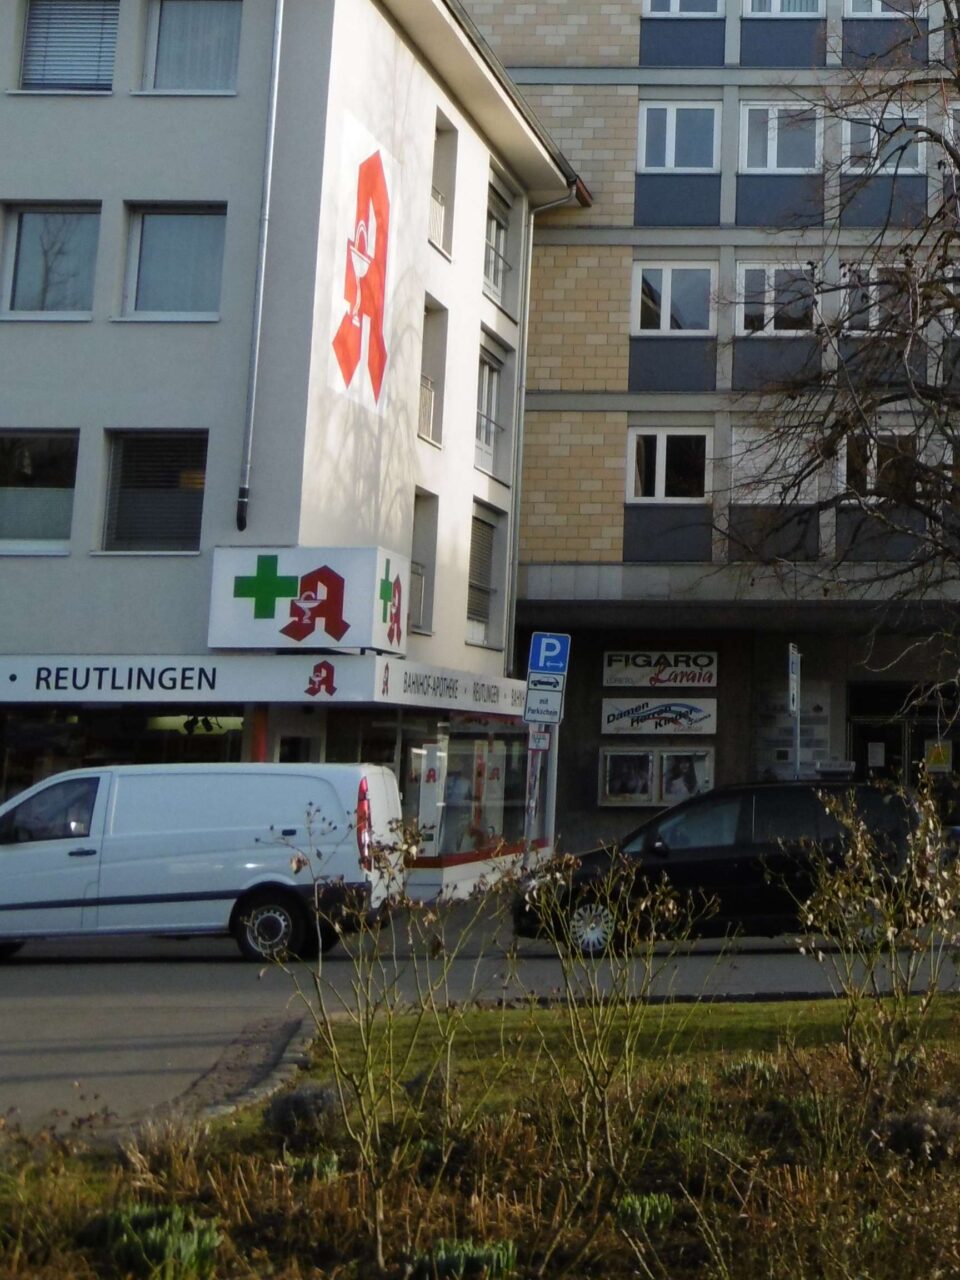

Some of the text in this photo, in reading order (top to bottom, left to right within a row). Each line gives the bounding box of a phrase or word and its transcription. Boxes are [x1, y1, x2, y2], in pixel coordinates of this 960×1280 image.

[539, 637, 561, 667] P
[607, 653, 715, 668] FIGARO
[35, 667, 217, 690] REUTLINGEN
[472, 681, 500, 704] REUTLINGEN
[539, 697, 549, 705] mit
[527, 705, 558, 717] Parkschein
[606, 701, 649, 724] Damen
[630, 705, 672, 727] Herren
[654, 708, 693, 730] Kinder
